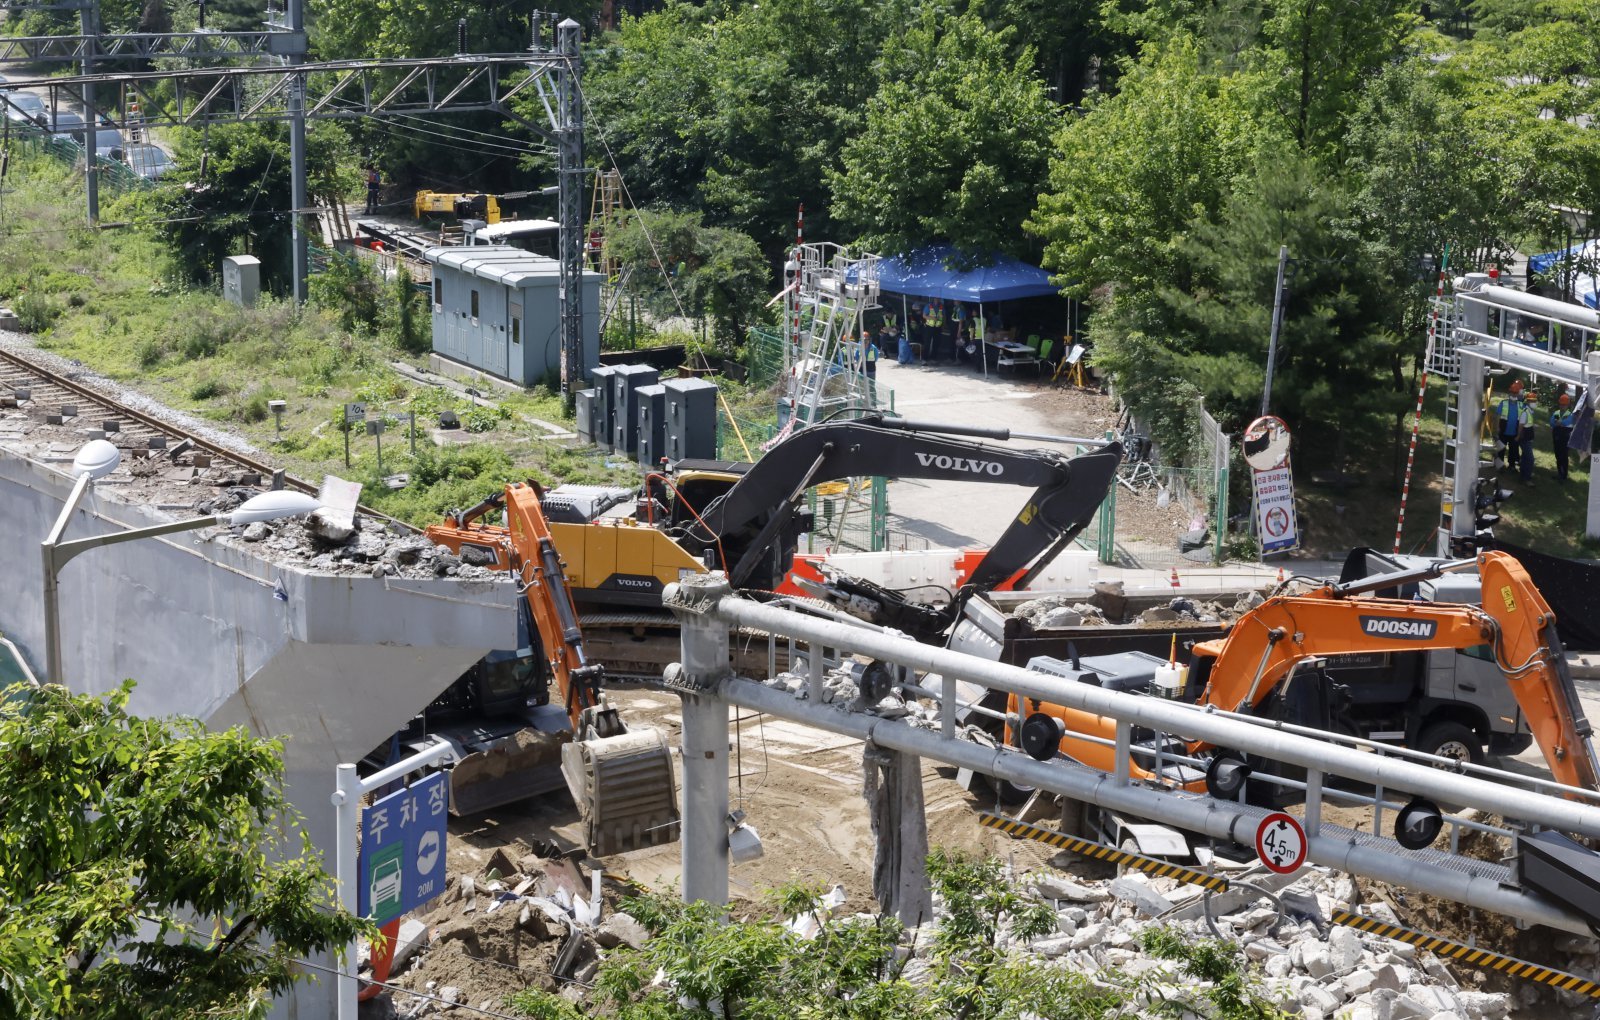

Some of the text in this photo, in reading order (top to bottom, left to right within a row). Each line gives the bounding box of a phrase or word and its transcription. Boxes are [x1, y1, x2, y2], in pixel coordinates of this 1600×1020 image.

[914, 452, 1004, 476] VOLVO
[617, 579, 652, 588] VOLVO
[970, 625, 997, 648] VOLVO
[1366, 619, 1432, 636] DOOSAN
[369, 780, 447, 845] 주차장
[1264, 828, 1296, 860] 4.5m
[417, 879, 434, 898] 20M
